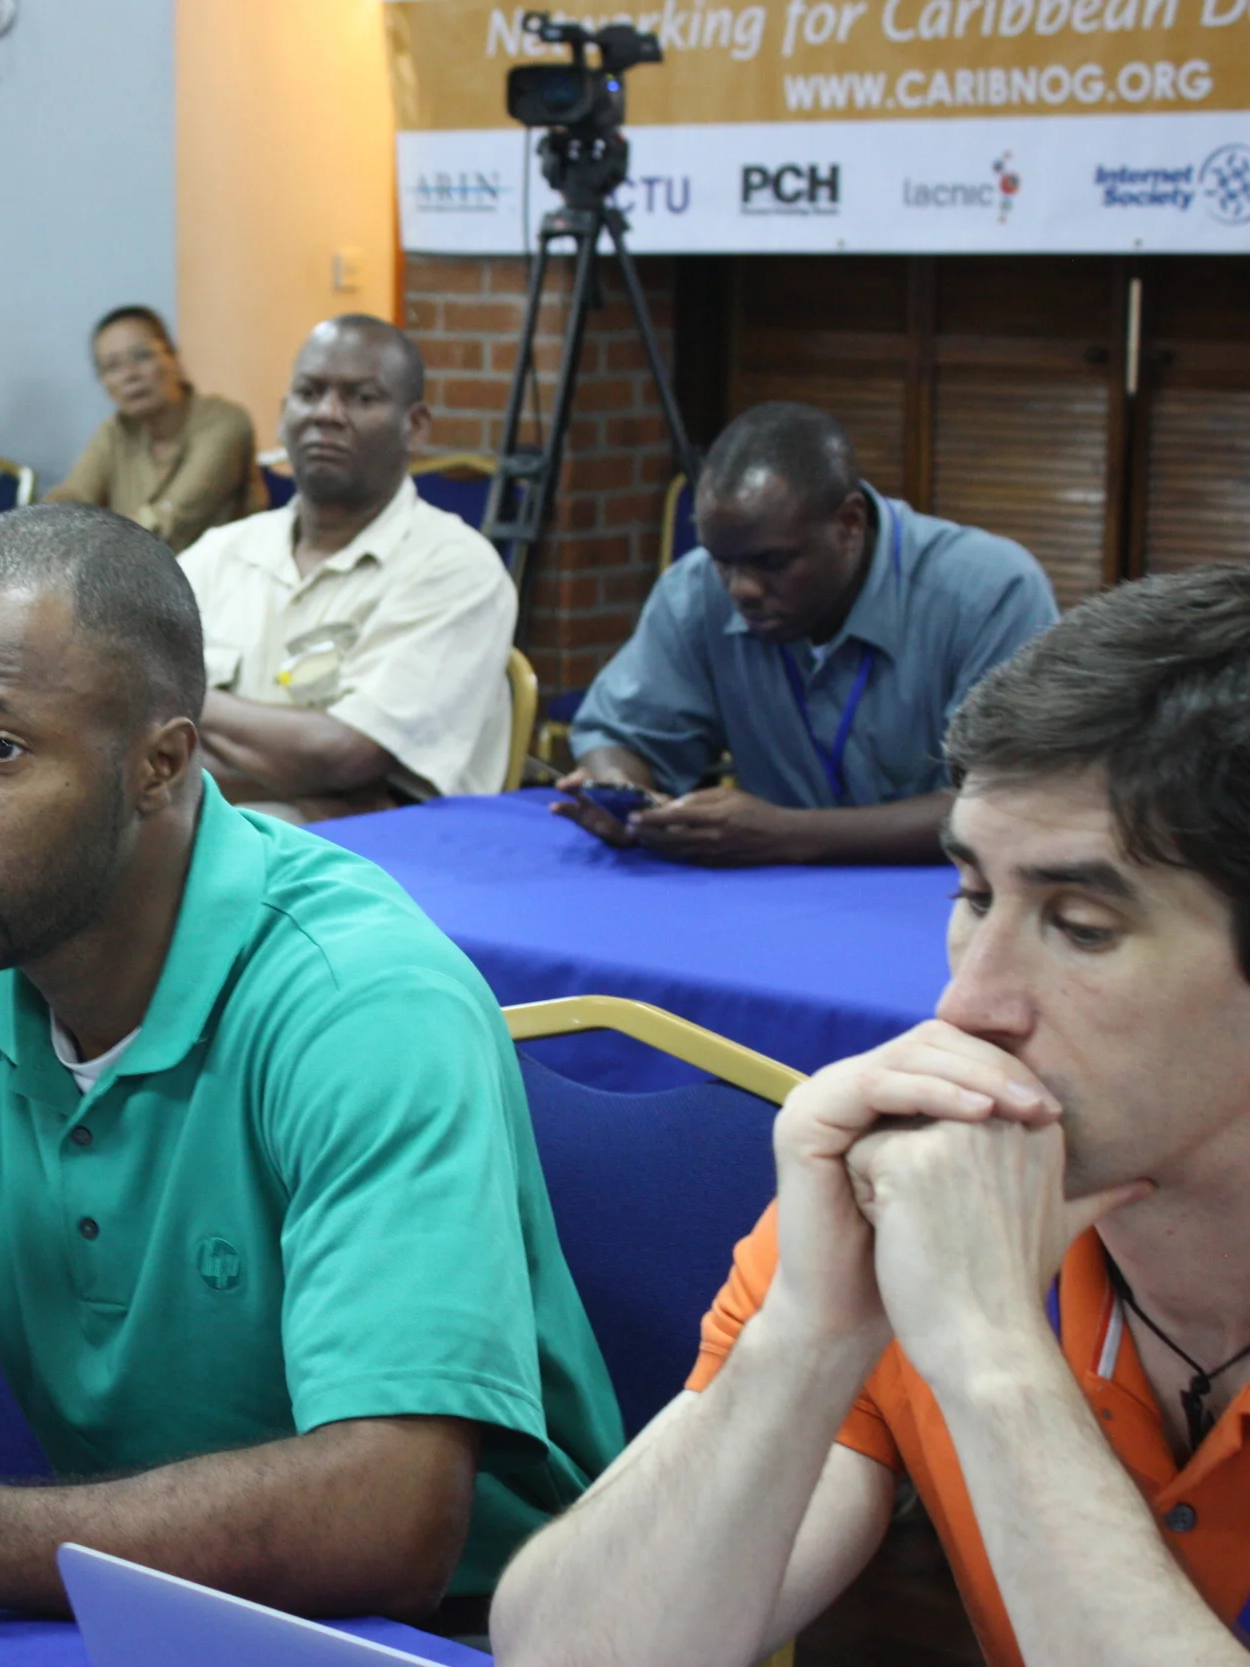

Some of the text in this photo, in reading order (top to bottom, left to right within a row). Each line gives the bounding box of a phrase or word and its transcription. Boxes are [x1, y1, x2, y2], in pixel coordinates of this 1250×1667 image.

[485, 0, 1250, 60] Netrking for Caribbean D
[783, 58, 1213, 111] WWW.CARIBNOG.ORG
[414, 170, 501, 202] ARIN
[741, 162, 841, 205] PCH
[1095, 164, 1193, 184] Internet
[1103, 185, 1194, 211] Society
